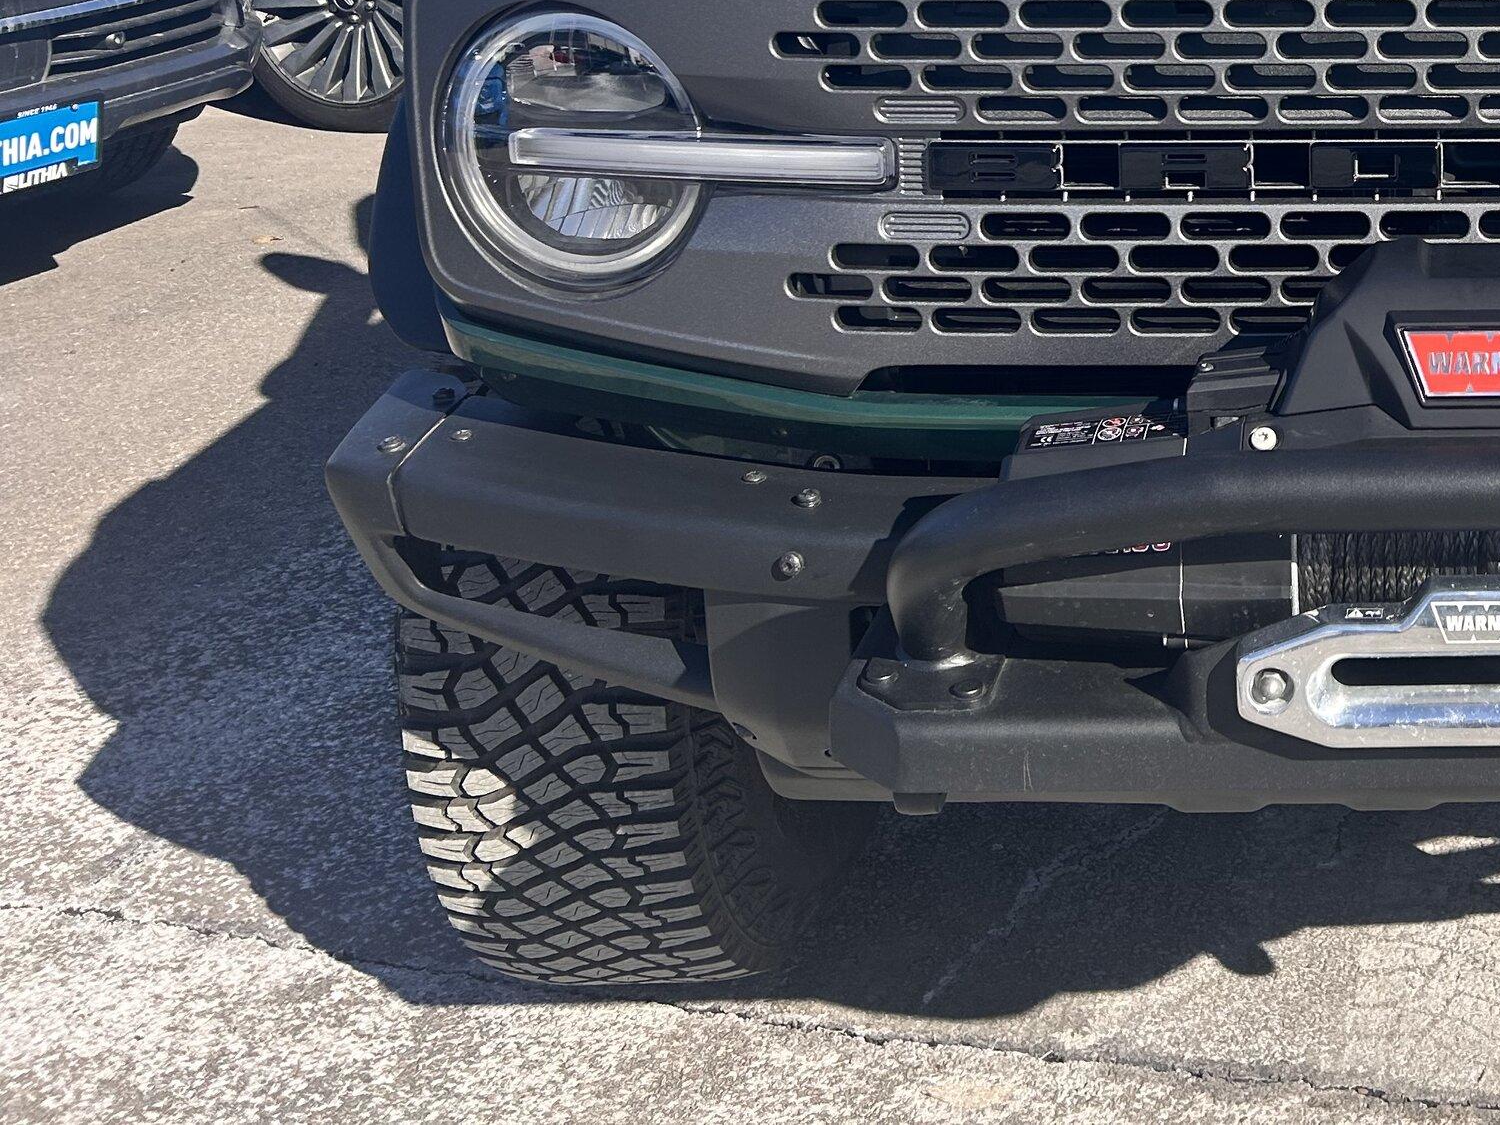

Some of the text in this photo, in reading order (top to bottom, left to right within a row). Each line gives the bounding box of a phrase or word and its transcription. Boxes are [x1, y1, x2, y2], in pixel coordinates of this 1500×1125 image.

[17, 107, 40, 118] SINCE
[0, 117, 98, 166] HIA.COM
[18, 161, 68, 188] LITHIA
[1446, 614, 1500, 632] WARN
